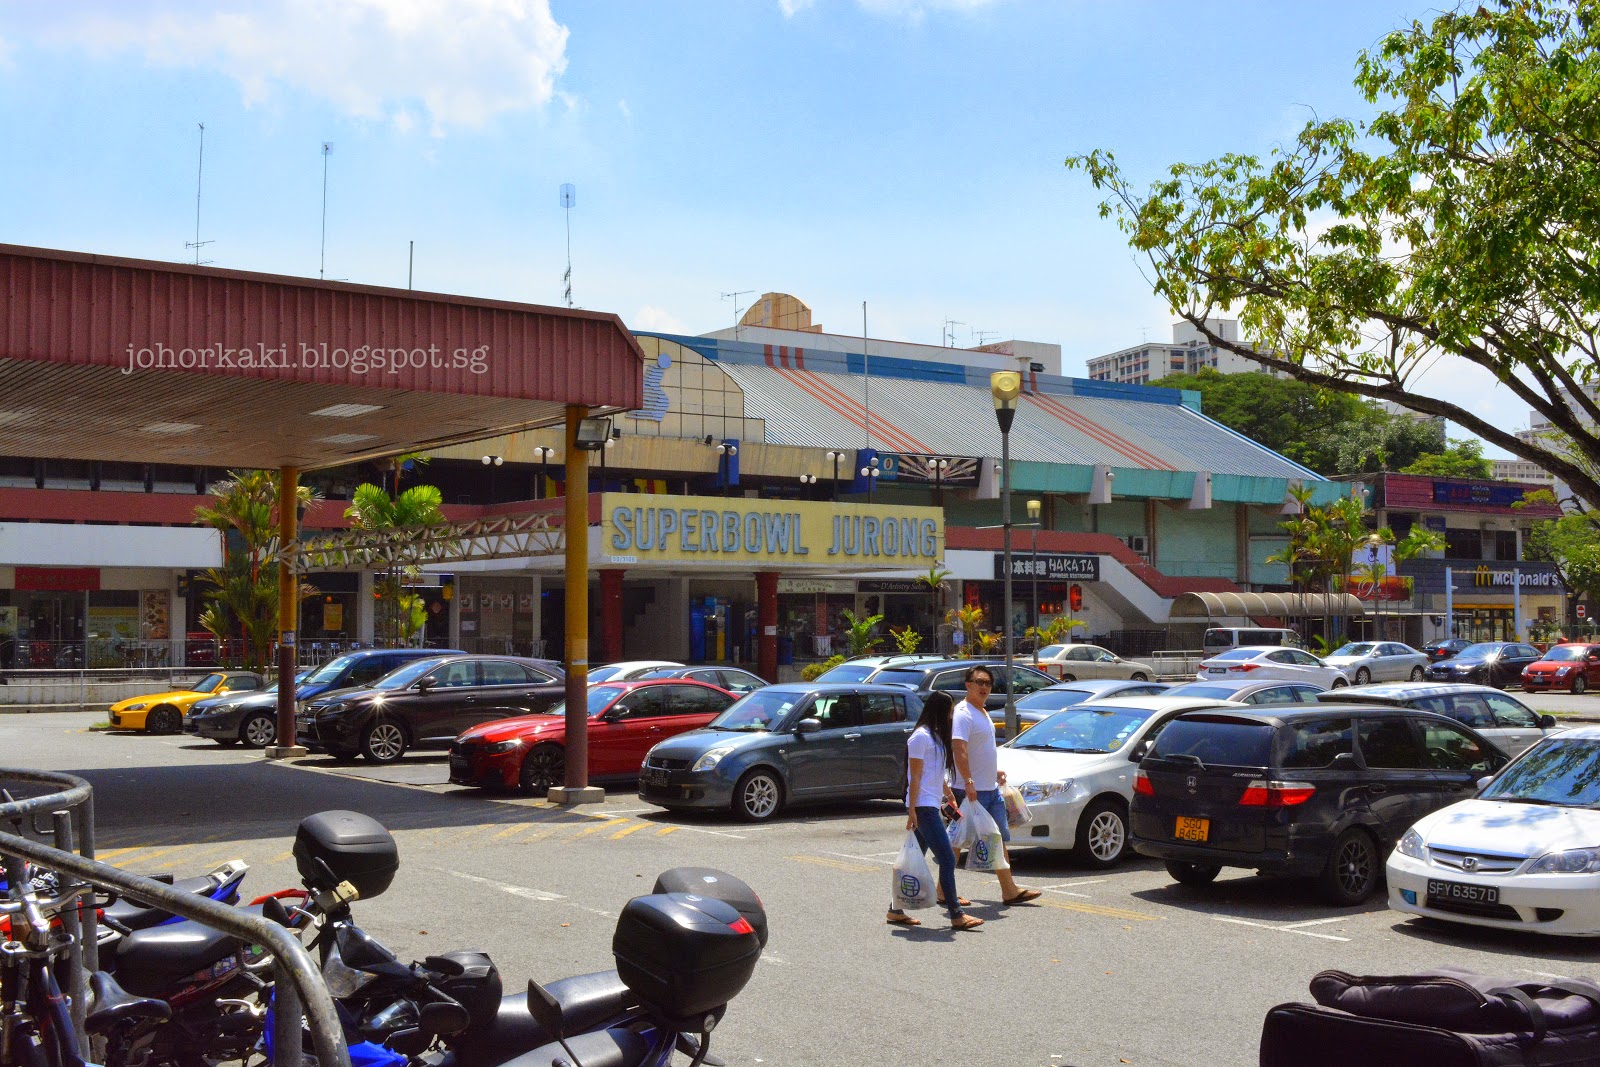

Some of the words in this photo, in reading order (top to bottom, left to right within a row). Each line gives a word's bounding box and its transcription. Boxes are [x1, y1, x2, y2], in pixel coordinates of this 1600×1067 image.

[611, 506, 808, 554] SUPERBOWL
[827, 514, 938, 557] JURONG
[1049, 558, 1095, 572] HAKATA
